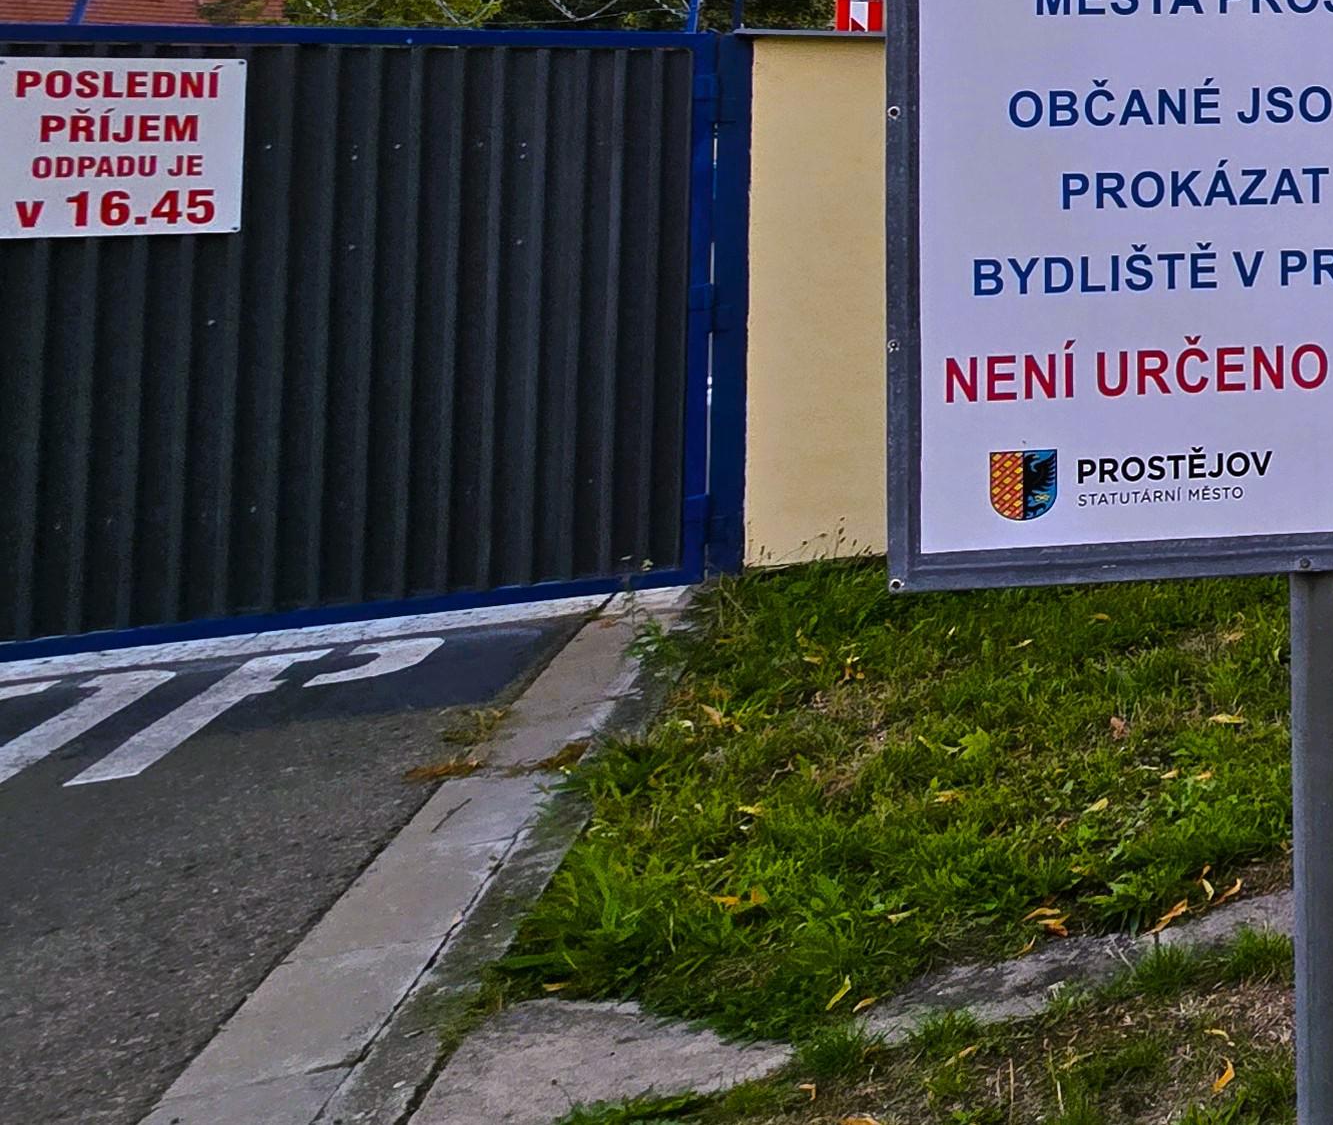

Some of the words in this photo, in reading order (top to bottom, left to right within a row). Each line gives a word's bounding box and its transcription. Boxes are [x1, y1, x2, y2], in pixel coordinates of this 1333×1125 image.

[16, 64, 223, 99] POSLEDNÍ
[1008, 77, 1221, 128] OBČANÉ
[40, 108, 198, 143] PŘÍJEM
[32, 155, 157, 179] ODPADU
[167, 154, 203, 177] JE
[1062, 159, 1330, 210] PROKÁZAT
[65, 189, 215, 227] 16.45
[973, 242, 1218, 296] BYDLIŠTĚ
[1232, 250, 1265, 288] V
[945, 339, 1076, 404] NENÍ
[1096, 335, 1328, 397] URČENO
[1077, 446, 1273, 485] PROSTĚJOV
[1078, 486, 1182, 507] STATUTÁRNÍ
[1188, 485, 1244, 501] MĚSTO
